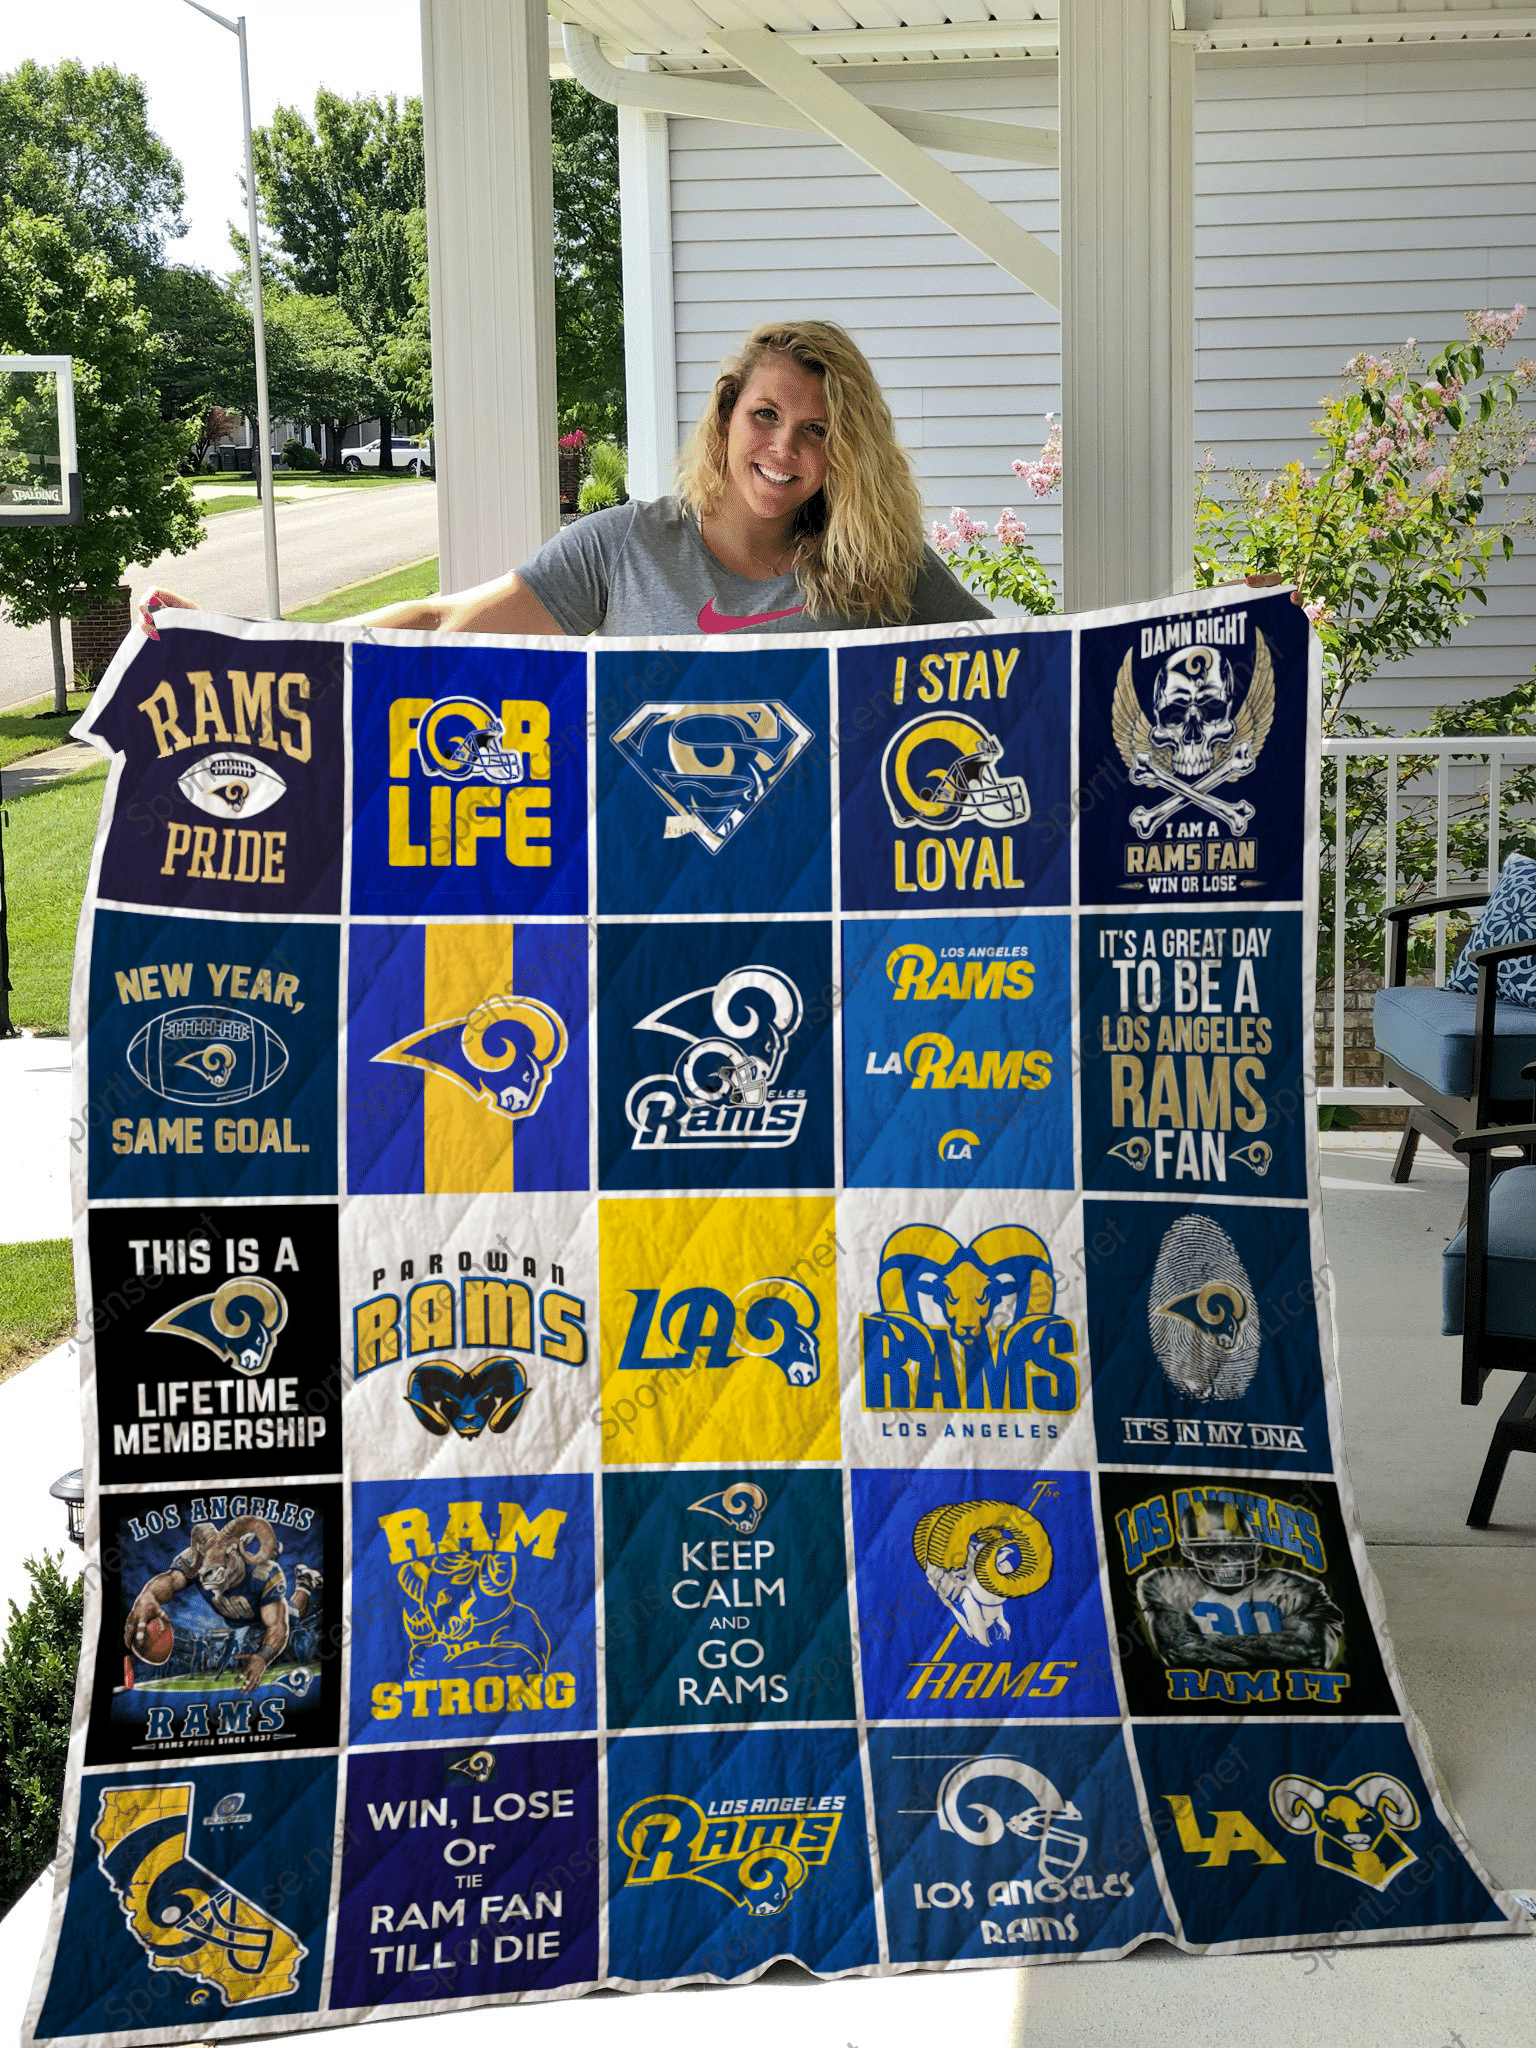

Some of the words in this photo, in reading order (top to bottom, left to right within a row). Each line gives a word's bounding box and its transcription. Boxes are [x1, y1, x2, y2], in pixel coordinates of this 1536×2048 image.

[12, 489, 60, 501] SPALDING
[1140, 620, 1193, 661] DAMN
[1194, 610, 1249, 647] RIGHT
[894, 656, 906, 704] I
[917, 647, 1021, 702] STAY
[137, 669, 312, 764] RAMS
[389, 697, 551, 780] FR
[389, 786, 551, 866] LIFE
[1165, 823, 1173, 839] I
[1176, 822, 1203, 838] AM
[1206, 821, 1220, 837] A
[160, 822, 287, 884] PRIDE
[894, 836, 1025, 892] LOYAL
[1125, 842, 1204, 875] RAMS
[1207, 838, 1257, 871] FAN
[1147, 876, 1179, 894] WIN
[1182, 876, 1199, 893] OR
[1202, 875, 1238, 893] LOSE
[940, 947, 967, 958] LOS
[969, 946, 1028, 957] ANGELES
[1100, 929, 1137, 958] IT'S
[1142, 929, 1156, 957] A
[1162, 928, 1226, 957] GREAT
[1232, 928, 1272, 958] DAY
[114, 962, 193, 1005] NEW
[206, 962, 305, 1014] YEAR,
[887, 943, 1035, 1000] RAMS
[1112, 959, 1161, 1013] TO
[1174, 959, 1222, 1013] BE
[1233, 959, 1260, 1013] A
[1102, 1015, 1150, 1052] LOS
[1157, 1015, 1272, 1055] ANGELES
[866, 1052, 903, 1075] LA
[904, 1031, 1053, 1090] RAMS
[767, 1089, 807, 1099] ELES
[1111, 1055, 1267, 1132] RAMS
[111, 1117, 203, 1154] SAME
[214, 1117, 310, 1154] GOAL.
[947, 1143, 972, 1160] LA
[1154, 1129, 1226, 1181] FAN
[128, 1238, 211, 1276] THIS
[225, 1237, 260, 1274] IS
[273, 1236, 300, 1272] A
[353, 1275, 588, 1380] RAMS
[618, 1287, 749, 1370] LA
[859, 1312, 1080, 1413] RAMS
[137, 1376, 299, 1418] LIFETIME
[113, 1414, 327, 1455] MEMBERSHIP
[882, 1422, 927, 1437] LOS
[944, 1423, 1058, 1439] ANGELES
[1124, 1420, 1170, 1441] IT'S
[1176, 1422, 1201, 1443] IN
[1207, 1424, 1243, 1444] MY
[1251, 1426, 1305, 1449] DNA
[1031, 1480, 1062, 1510] The
[128, 1504, 181, 1541] LOS
[191, 1495, 315, 1531] ANGELES
[378, 1501, 568, 1565] RAM
[1115, 1495, 1174, 1575] LOS
[1172, 1486, 1327, 1574] AELES
[682, 1540, 775, 1571] KEEP
[671, 1577, 786, 1609] CALM
[709, 1615, 750, 1629] AND
[698, 1639, 765, 1669] GO
[371, 1672, 576, 1720] STRONG
[678, 1674, 789, 1706] RAMS
[906, 1660, 1079, 1699] RAMS
[1166, 1669, 1279, 1703] RAM
[1286, 1670, 1351, 1703] IT
[145, 1698, 285, 1740] RAMS
[158, 1741, 184, 1749] RAMS
[187, 1739, 215, 1747] PRIDE
[218, 1736, 246, 1744] SINCE
[367, 1798, 458, 1832] WIN,
[472, 1788, 574, 1823] LOSE
[707, 1798, 747, 1816] LOS
[749, 1795, 846, 1815] ANGELES
[1161, 1794, 1287, 1867] LA
[442, 1838, 496, 1867] Or
[455, 1874, 482, 1889] TIE
[913, 1881, 974, 1910] LOS
[369, 1899, 466, 1935] RAM
[480, 1890, 564, 1925] FAN
[982, 1912, 1080, 1945] RAMS
[370, 1939, 463, 1975] TILL
[470, 1938, 478, 1966] I
[494, 1930, 560, 1961] DIE
